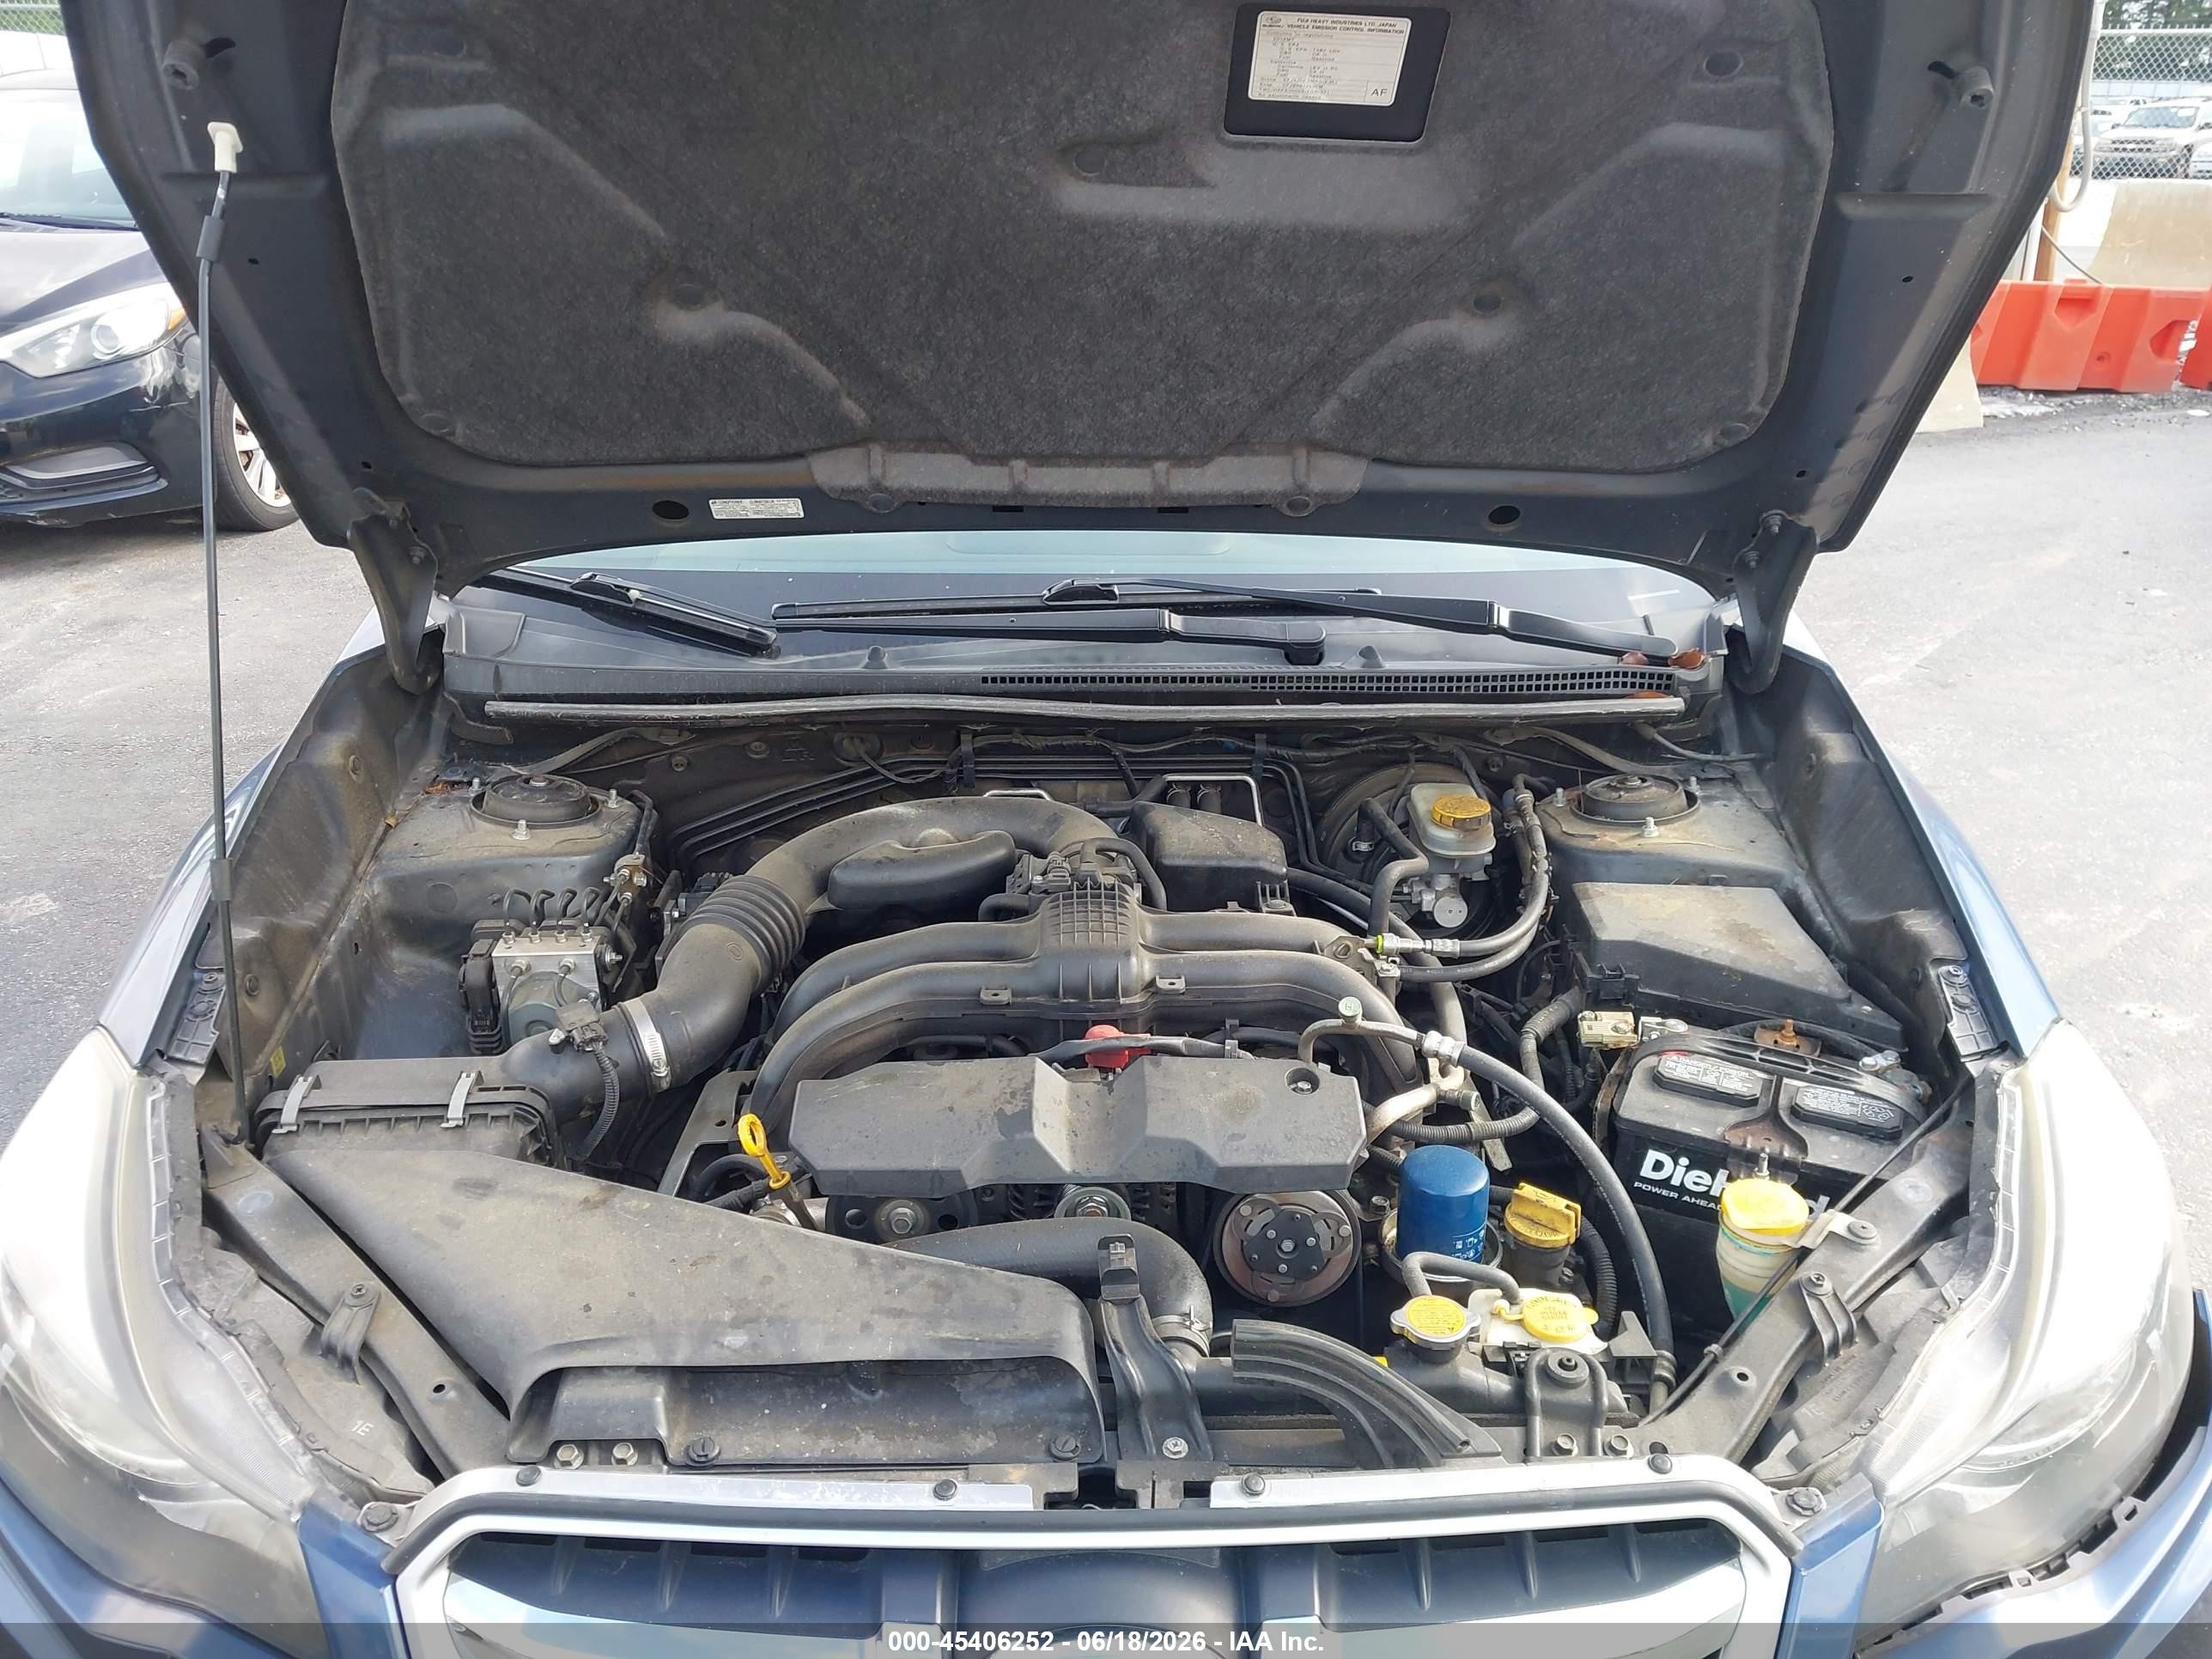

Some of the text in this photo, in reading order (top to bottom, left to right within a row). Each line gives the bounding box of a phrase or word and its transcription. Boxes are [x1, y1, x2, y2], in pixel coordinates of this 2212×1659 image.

[1370, 88, 1388, 97] AF
[1634, 1182, 1679, 1199] POWER
[351, 1420, 374, 1436] 1E
